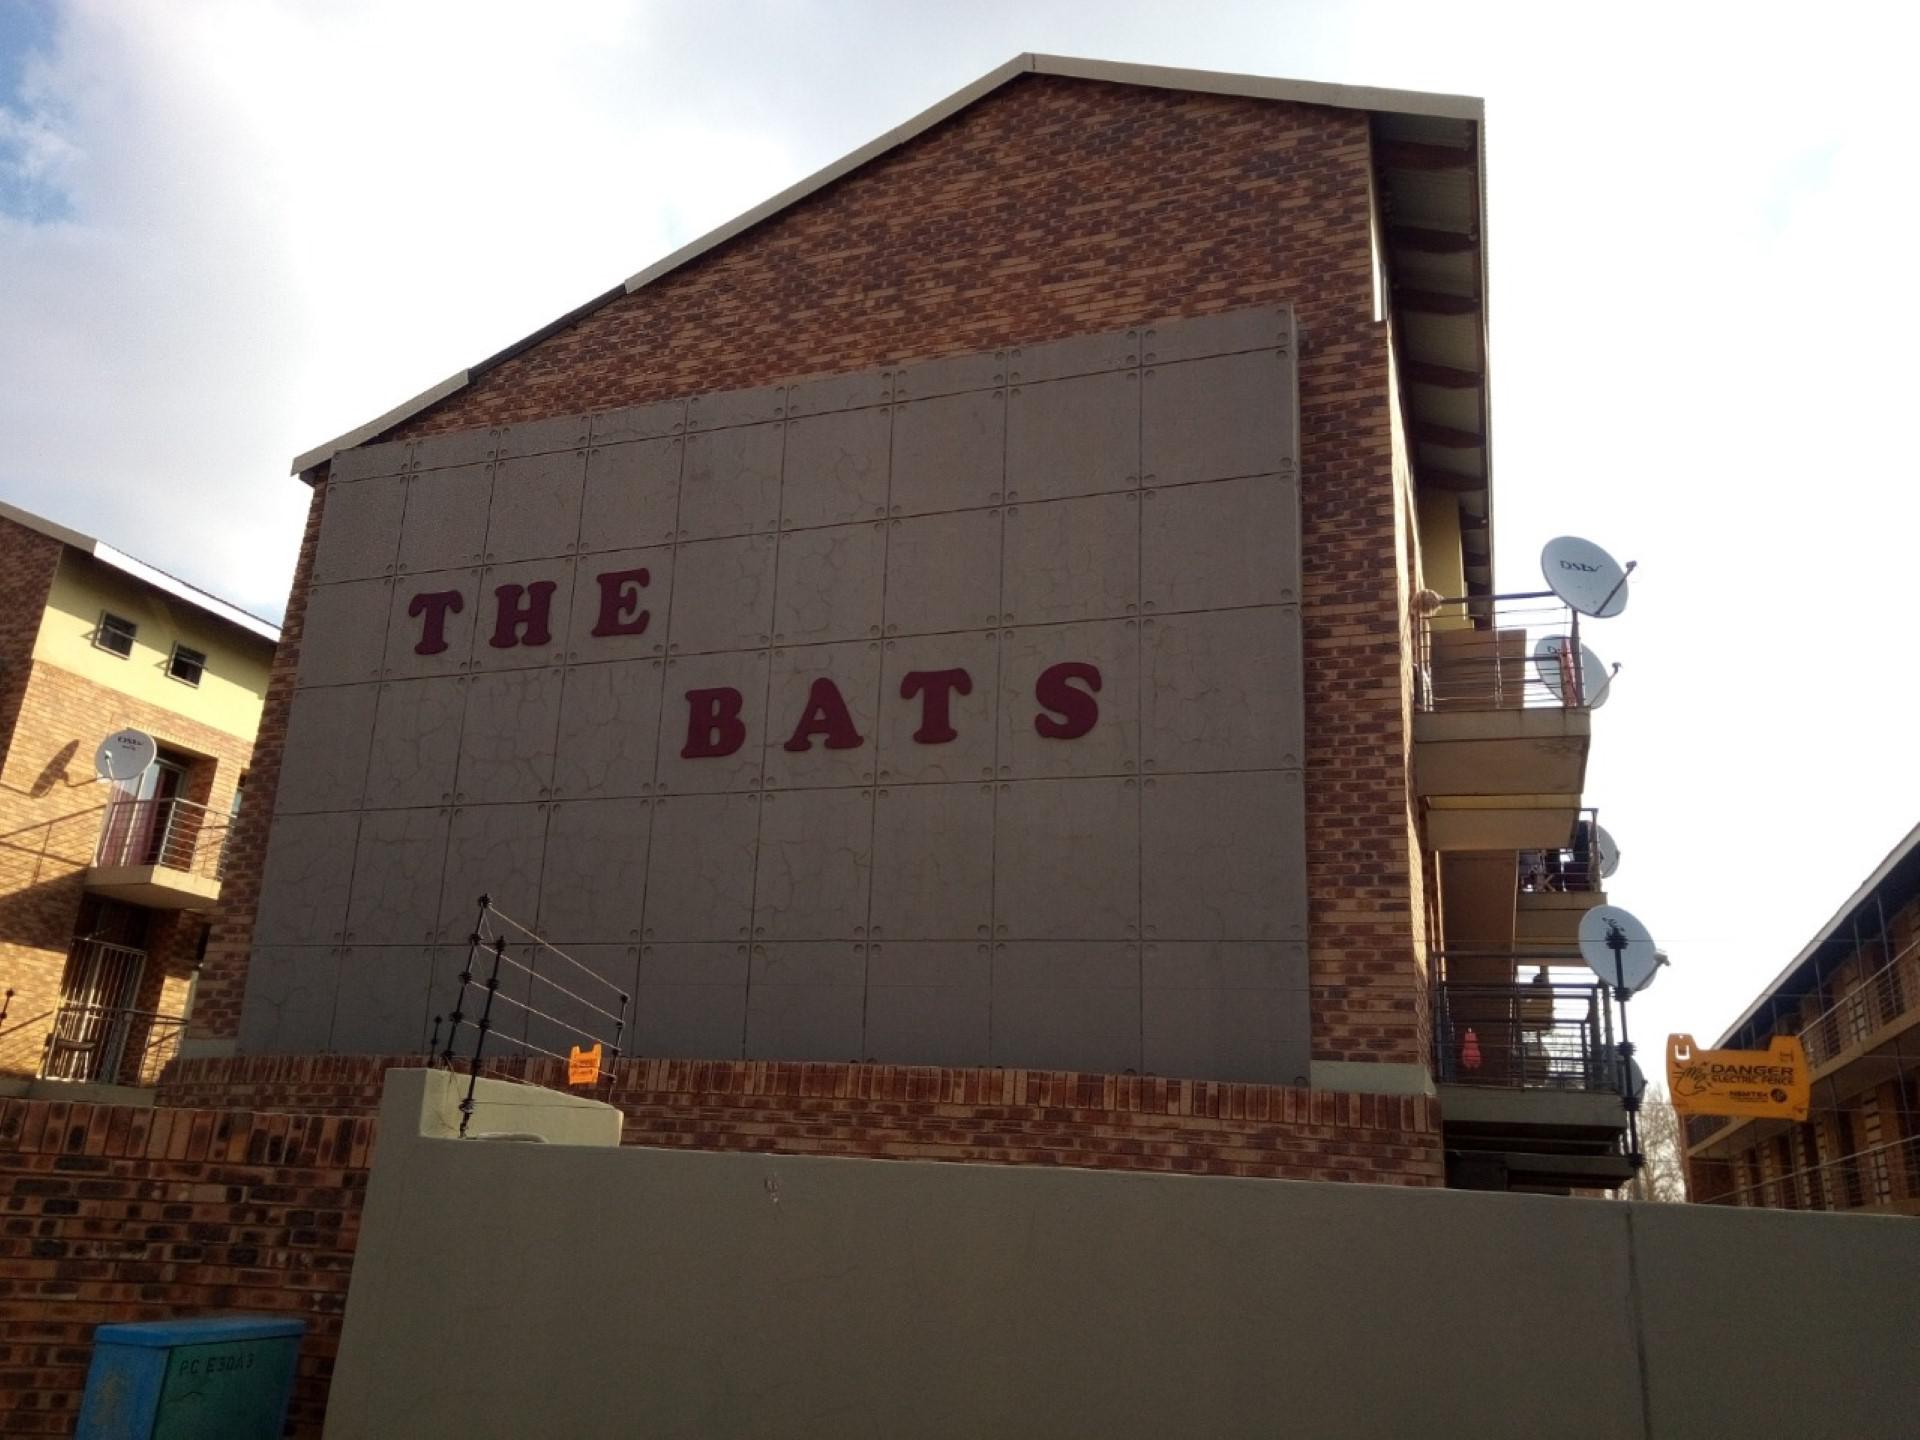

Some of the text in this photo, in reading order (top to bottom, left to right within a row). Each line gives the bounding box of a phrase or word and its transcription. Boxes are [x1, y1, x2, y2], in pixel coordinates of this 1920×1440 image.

[408, 568, 650, 655] THE
[681, 662, 1102, 759] BATS
[1711, 1064, 1794, 1076] DANGER
[1712, 1074, 1796, 1086] ELECTRIC FENCE
